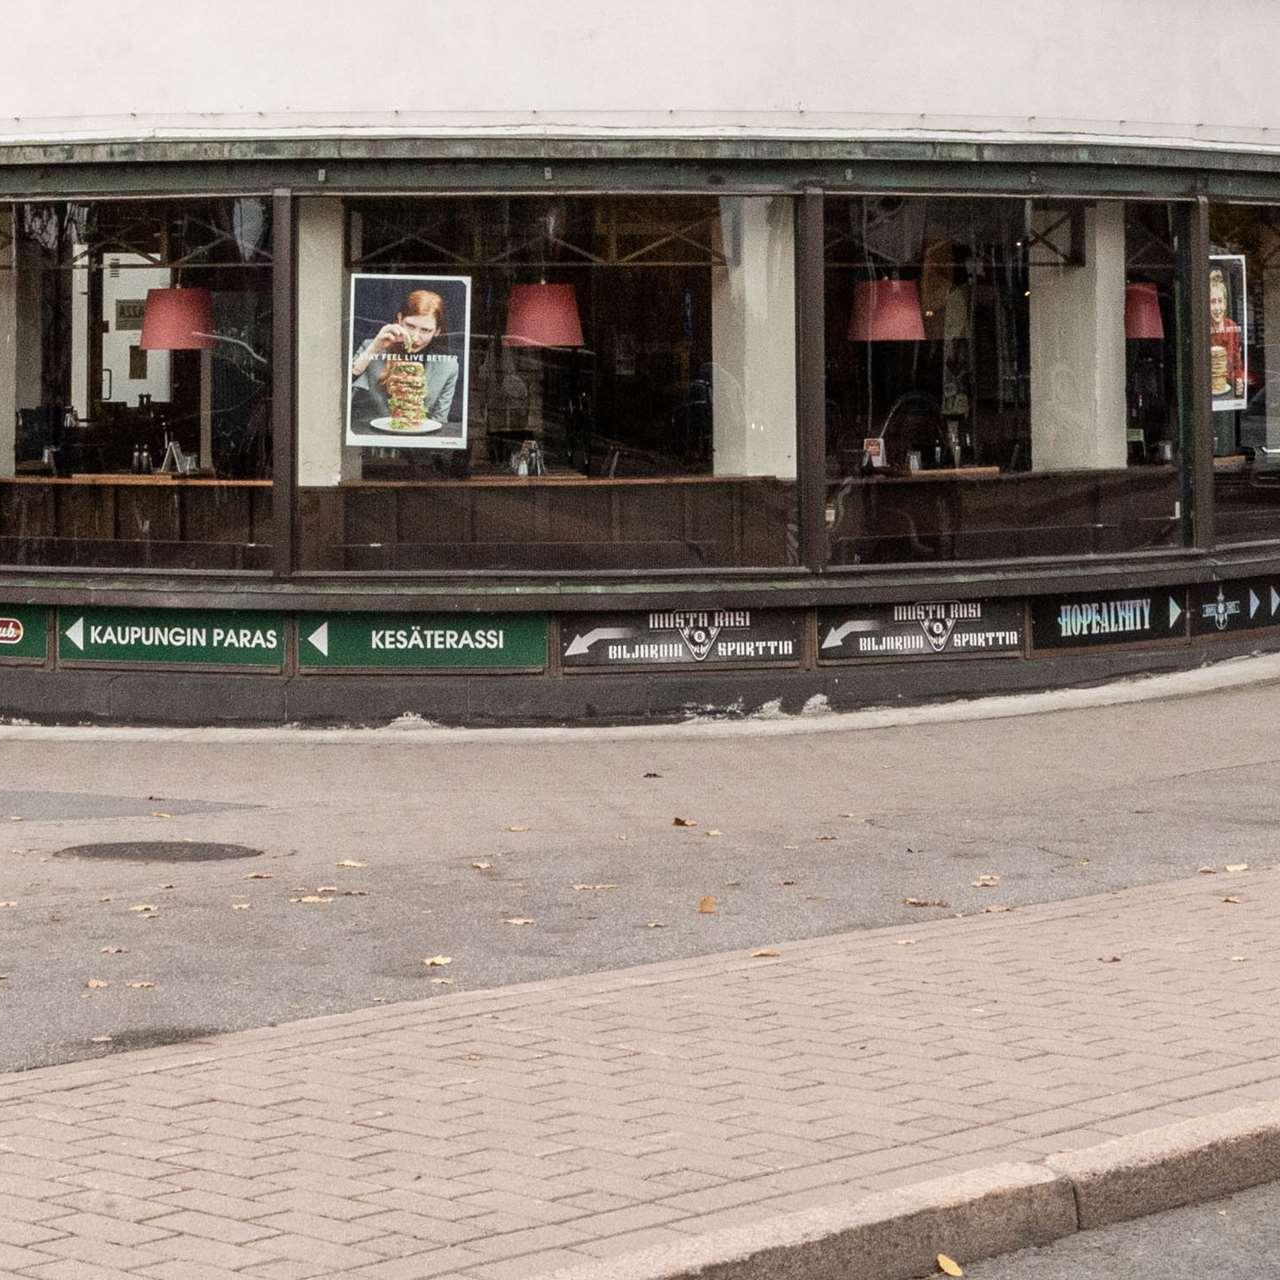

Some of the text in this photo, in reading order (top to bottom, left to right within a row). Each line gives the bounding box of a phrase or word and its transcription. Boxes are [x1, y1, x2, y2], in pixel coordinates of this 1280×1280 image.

[405, 354, 424, 362] LIVE
[1057, 598, 1151, 637] HOPEALYHTY
[90, 625, 277, 648] KAUPUNGIN PARAS
[371, 624, 504, 649] KESÄTERASSI
